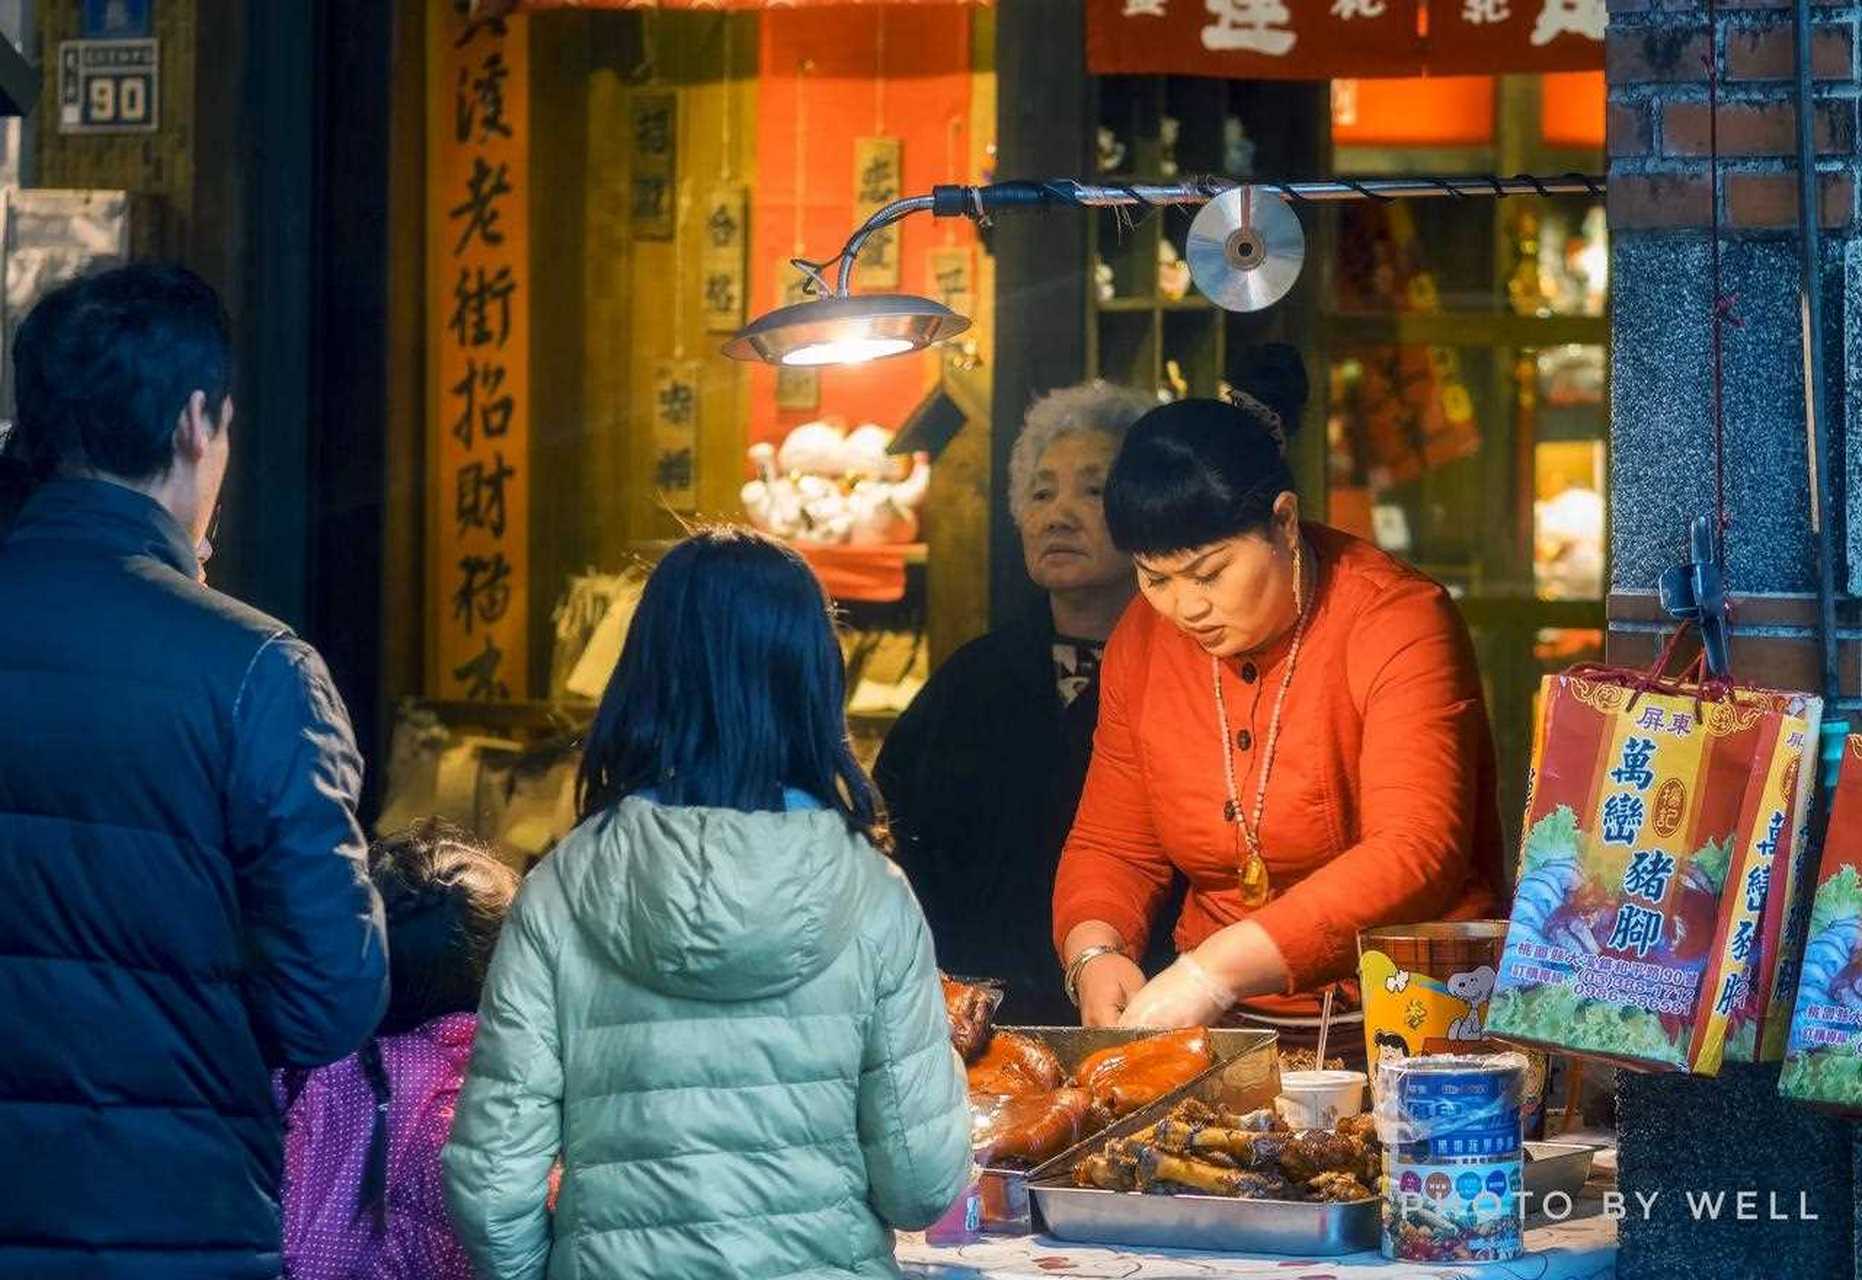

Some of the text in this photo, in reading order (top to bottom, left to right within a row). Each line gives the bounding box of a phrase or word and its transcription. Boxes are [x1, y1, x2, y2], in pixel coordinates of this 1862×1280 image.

[88, 77, 146, 120] 90
[1637, 706, 1692, 736] 屏東
[1602, 735, 1675, 956] 萬巒豬腳
